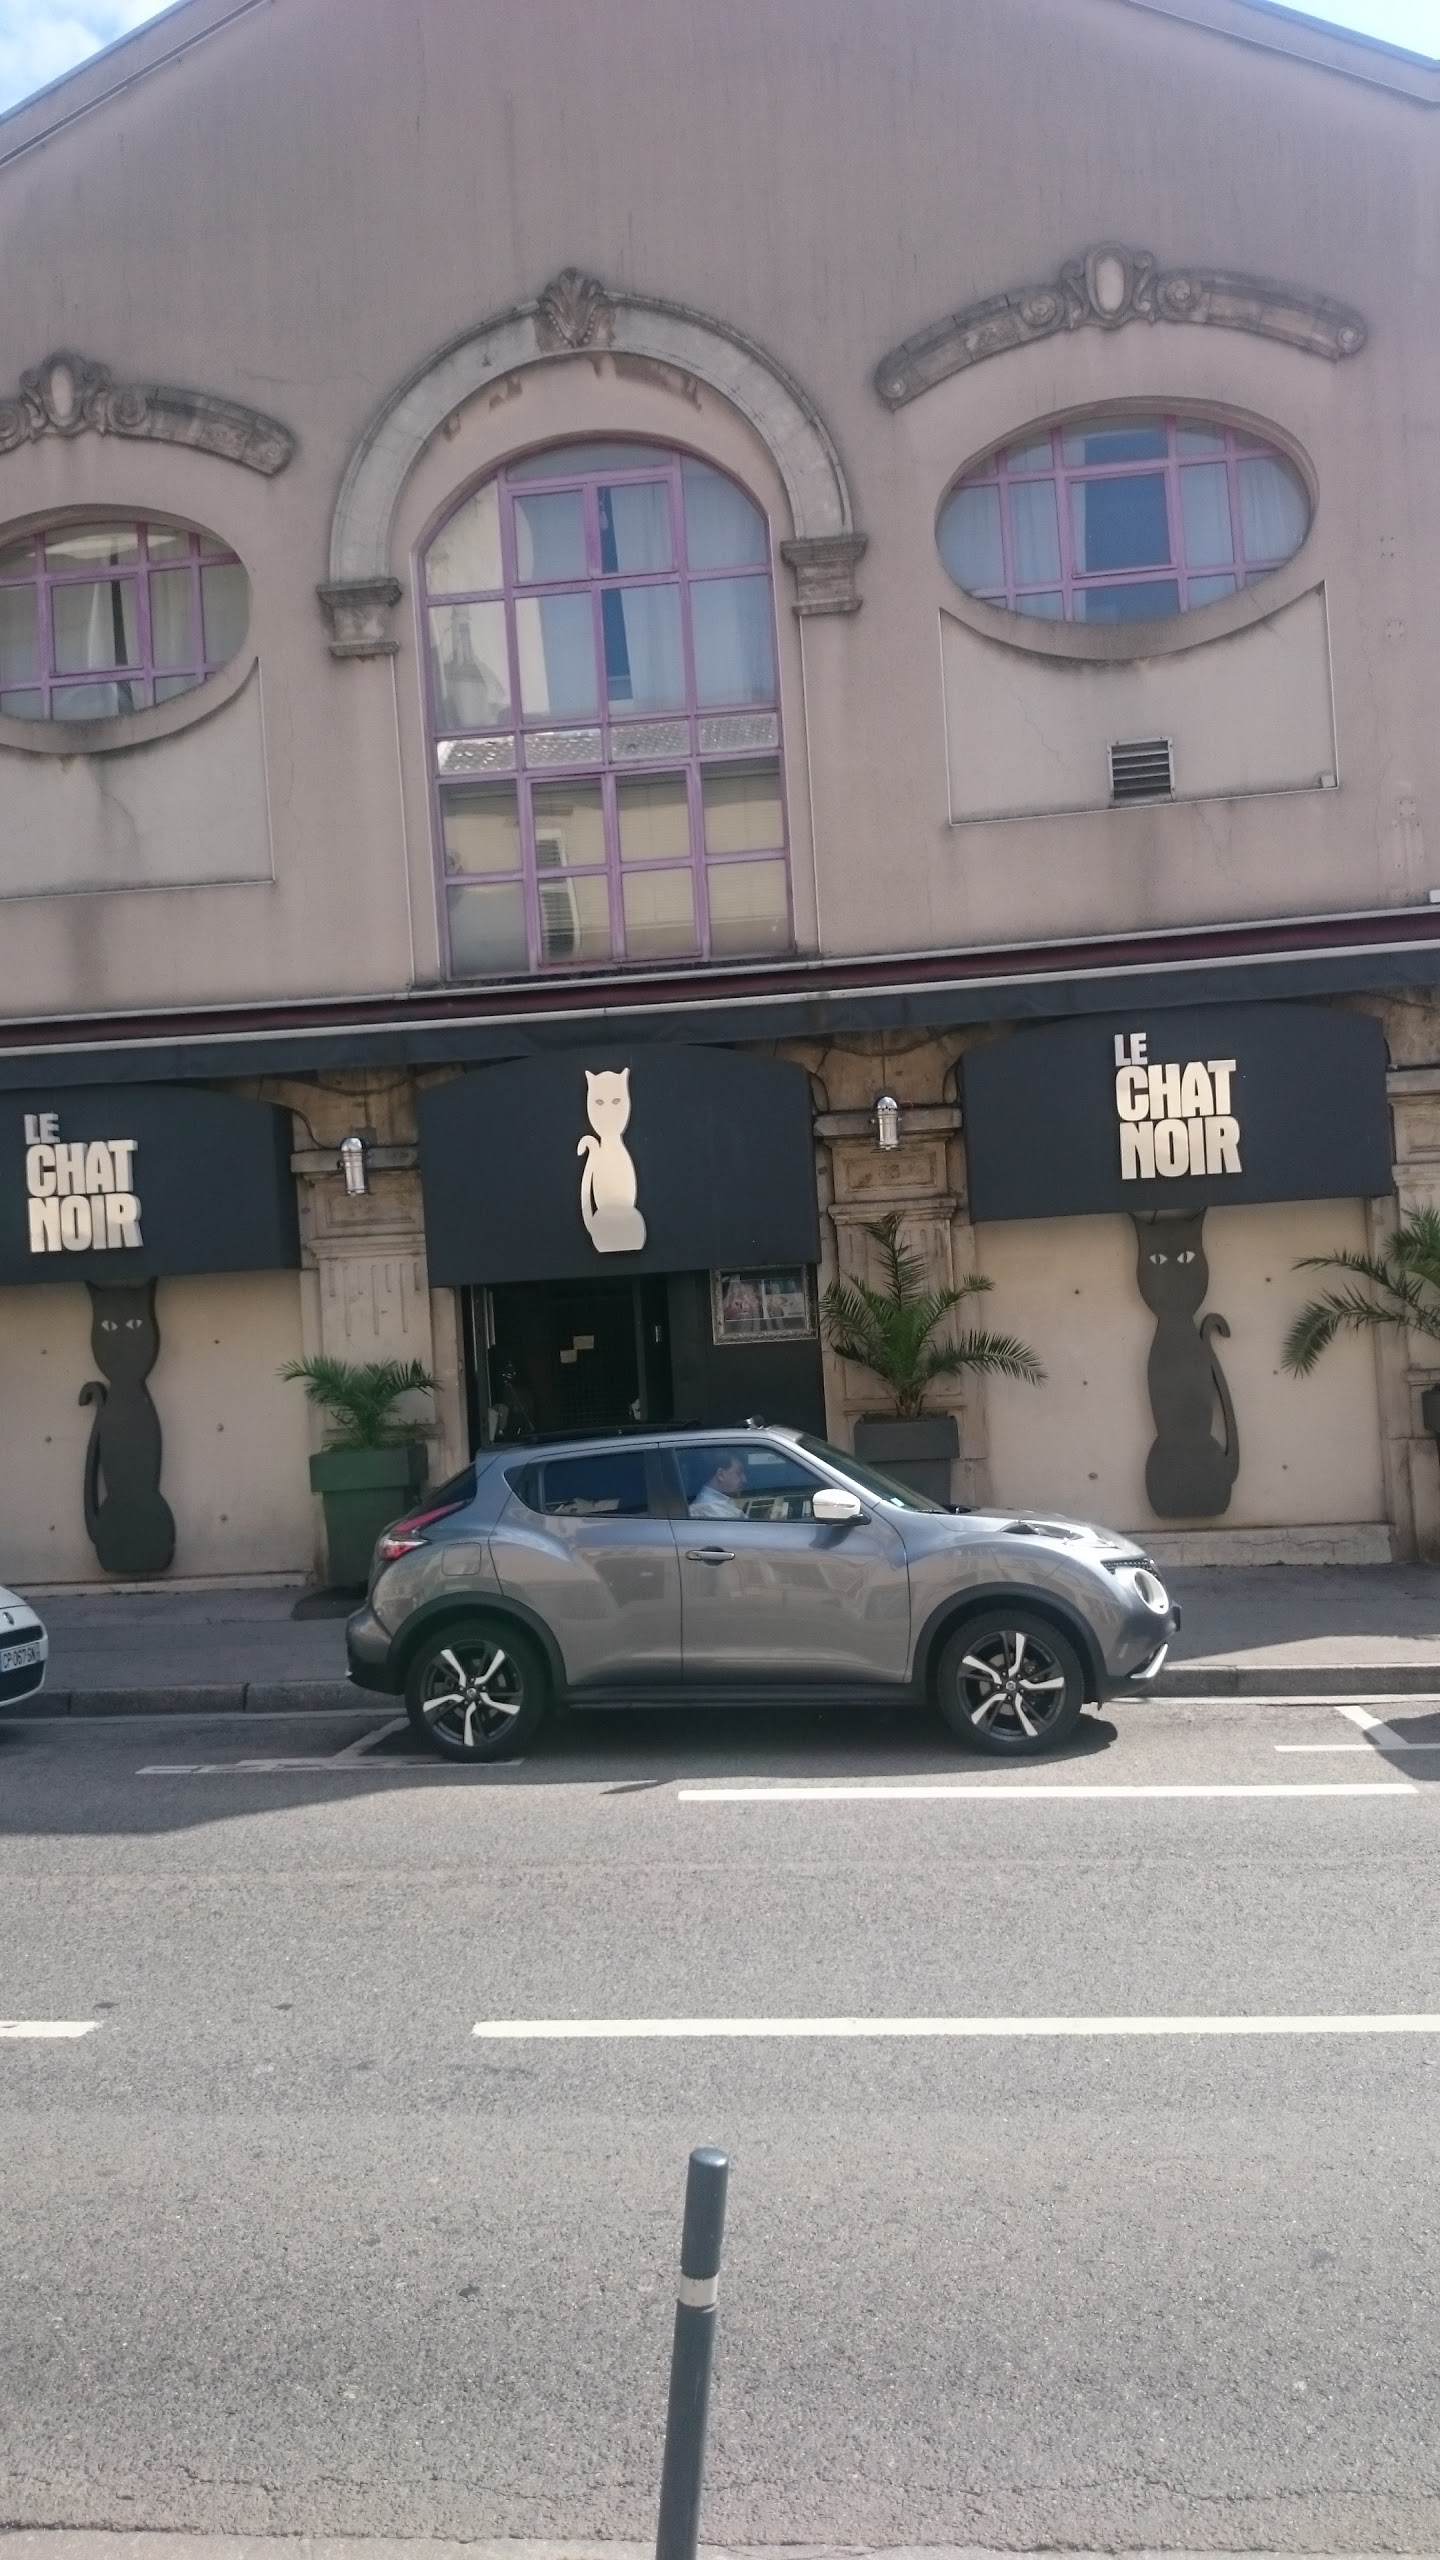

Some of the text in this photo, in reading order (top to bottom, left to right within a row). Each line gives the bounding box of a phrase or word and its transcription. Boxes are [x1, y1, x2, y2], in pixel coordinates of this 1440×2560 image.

[1114, 1032, 1148, 1066] LE
[1115, 1059, 1237, 1121] CHAT
[24, 1113, 60, 1144] LE
[1119, 1116, 1242, 1180] NOIR
[26, 1139, 138, 1198] CHAT
[28, 1193, 144, 1252] NOIR
